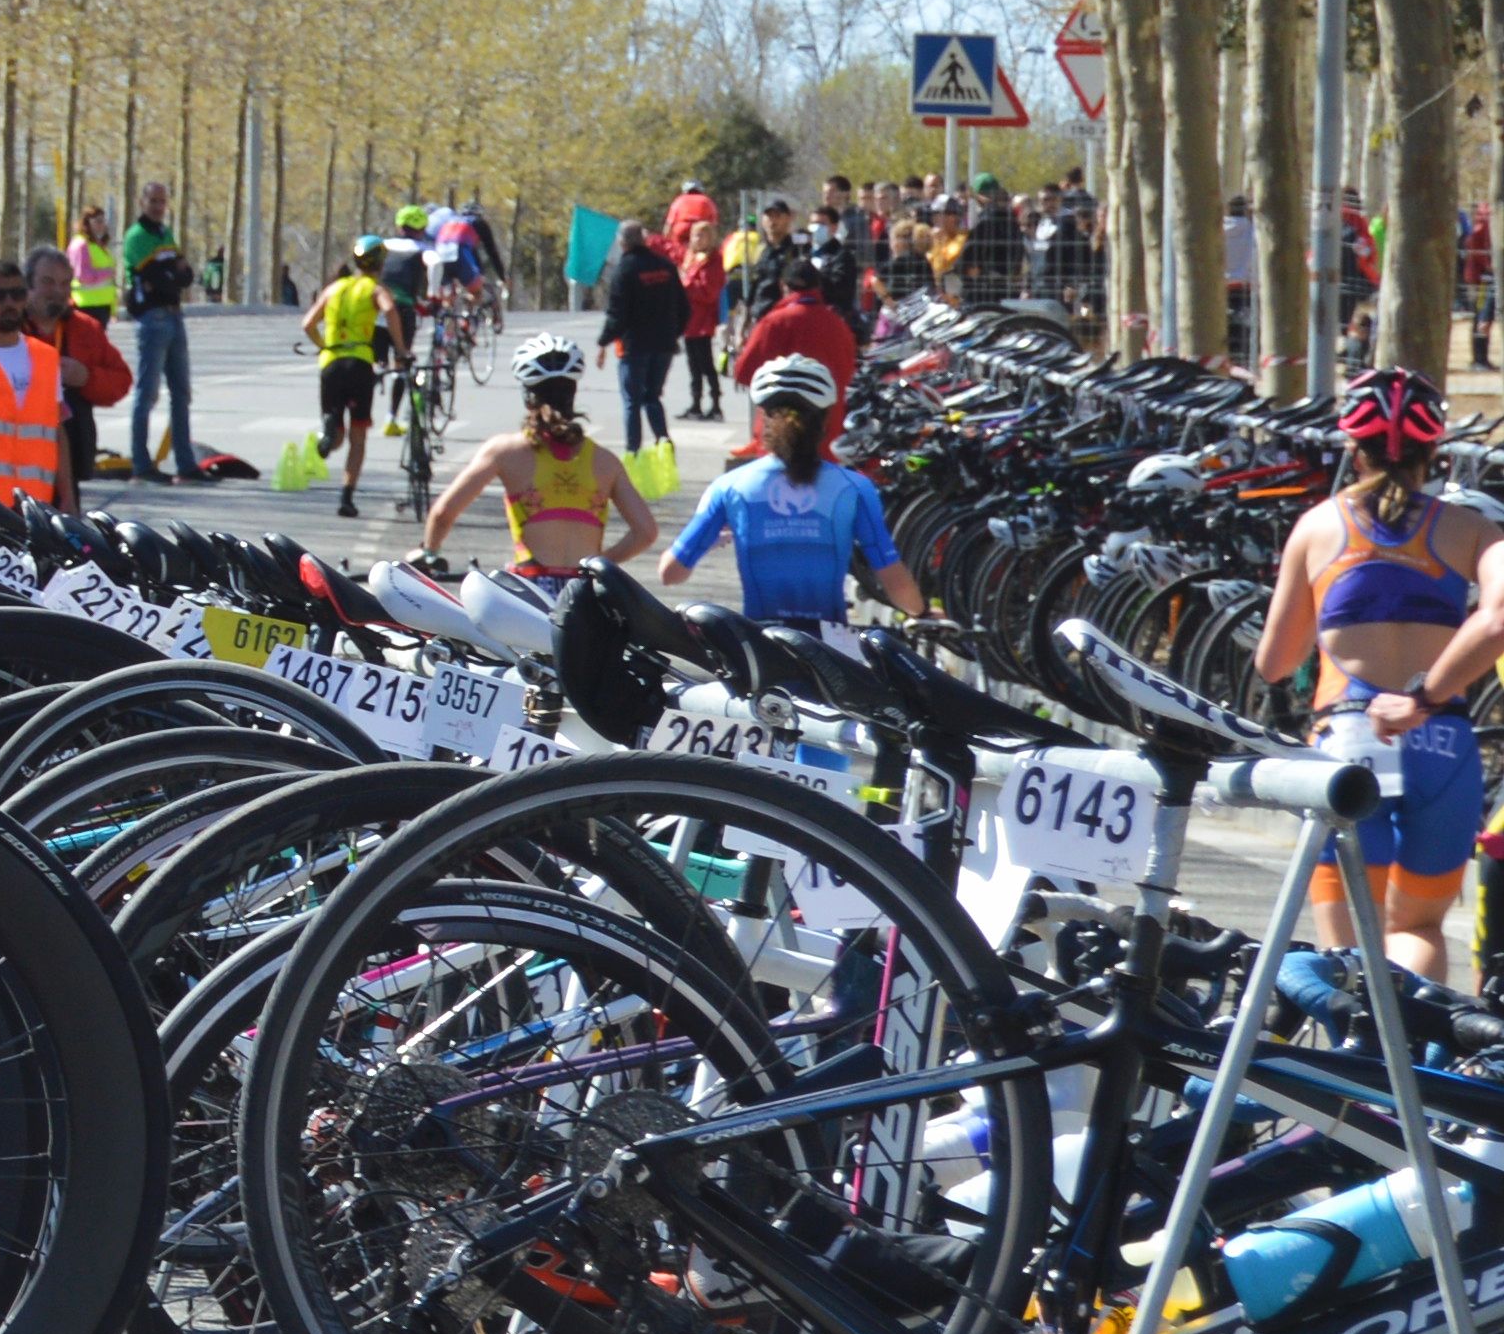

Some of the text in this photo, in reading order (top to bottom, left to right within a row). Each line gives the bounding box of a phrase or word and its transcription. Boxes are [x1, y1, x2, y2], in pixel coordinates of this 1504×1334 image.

[277, 651, 355, 705] 1487
[356, 668, 429, 723] 215
[437, 669, 500, 719] 3557
[664, 716, 765, 761] 2643
[1404, 725, 1458, 759] GUEZ
[1014, 766, 1137, 845] 6143
